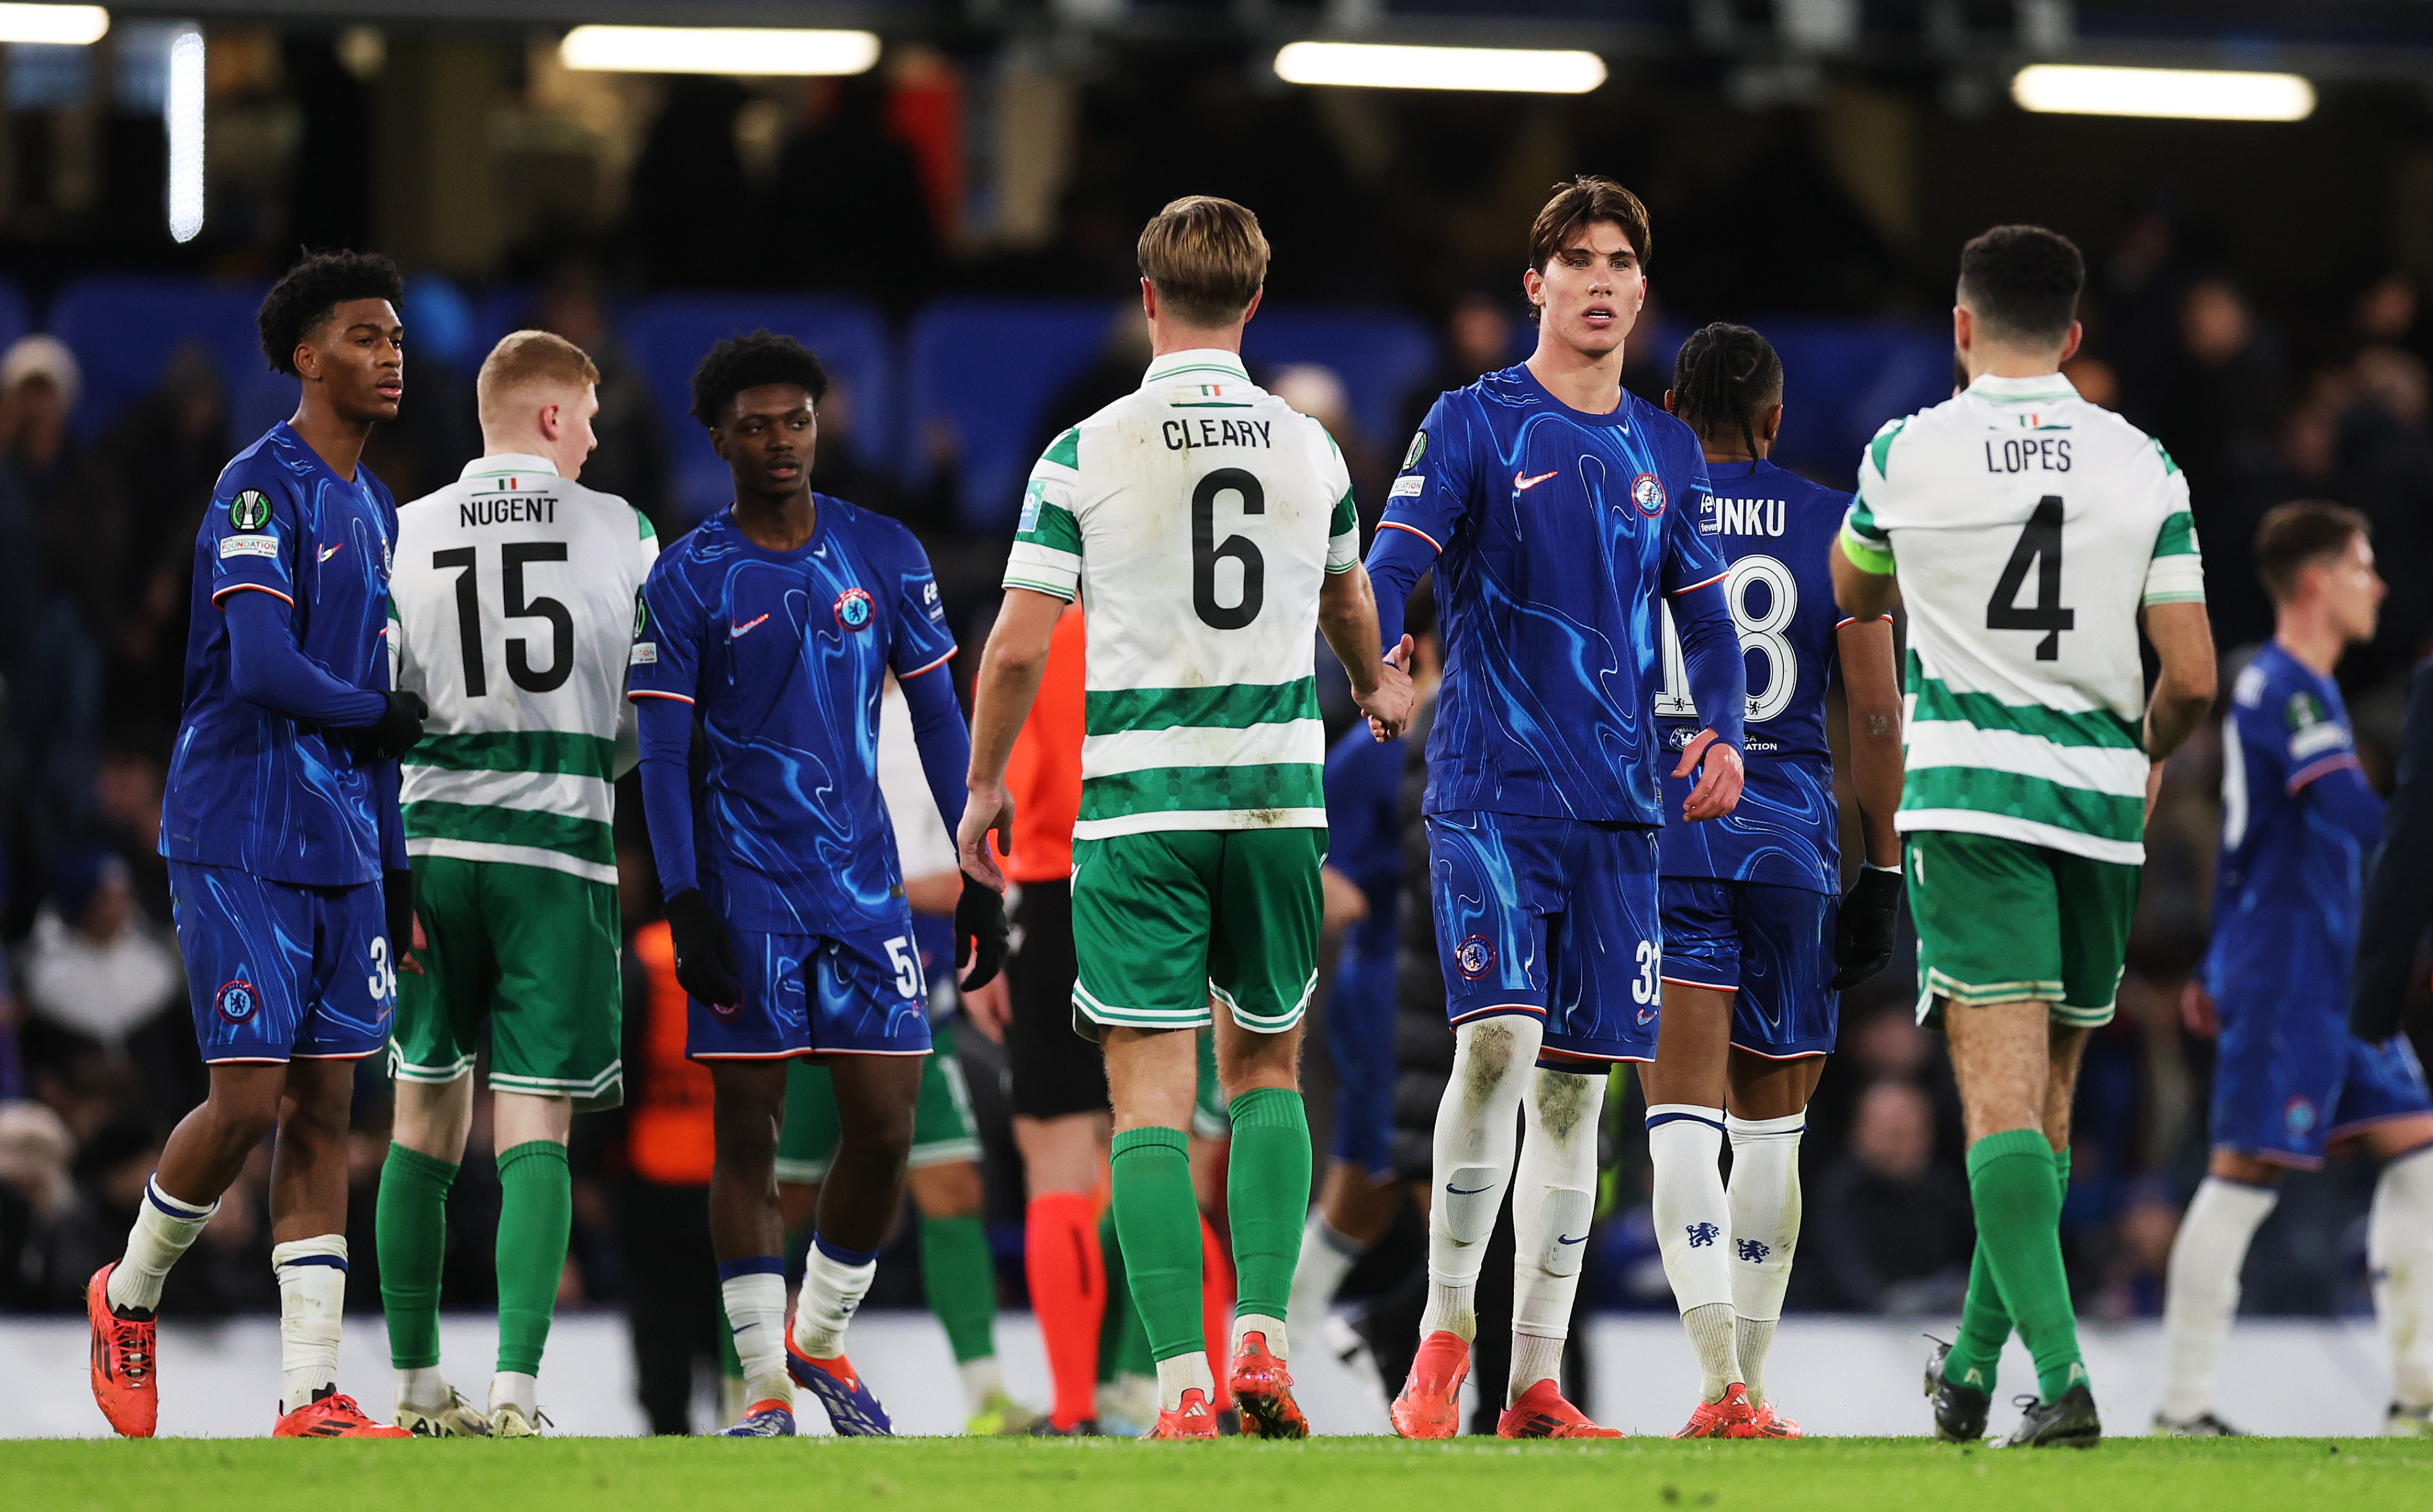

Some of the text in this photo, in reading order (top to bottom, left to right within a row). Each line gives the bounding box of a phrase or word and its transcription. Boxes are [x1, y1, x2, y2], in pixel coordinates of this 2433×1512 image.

[1162, 419, 1271, 450] CLEARY
[1986, 439, 2072, 473] LOPES
[460, 498, 558, 527] NUGENT
[222, 541, 276, 551] FOUNDATION
[1192, 468, 1265, 630] 6
[1987, 495, 2074, 661] 4
[433, 542, 574, 698] 15
[1675, 726, 1699, 735] CHELSEA
[1632, 940, 1662, 1006] 31
